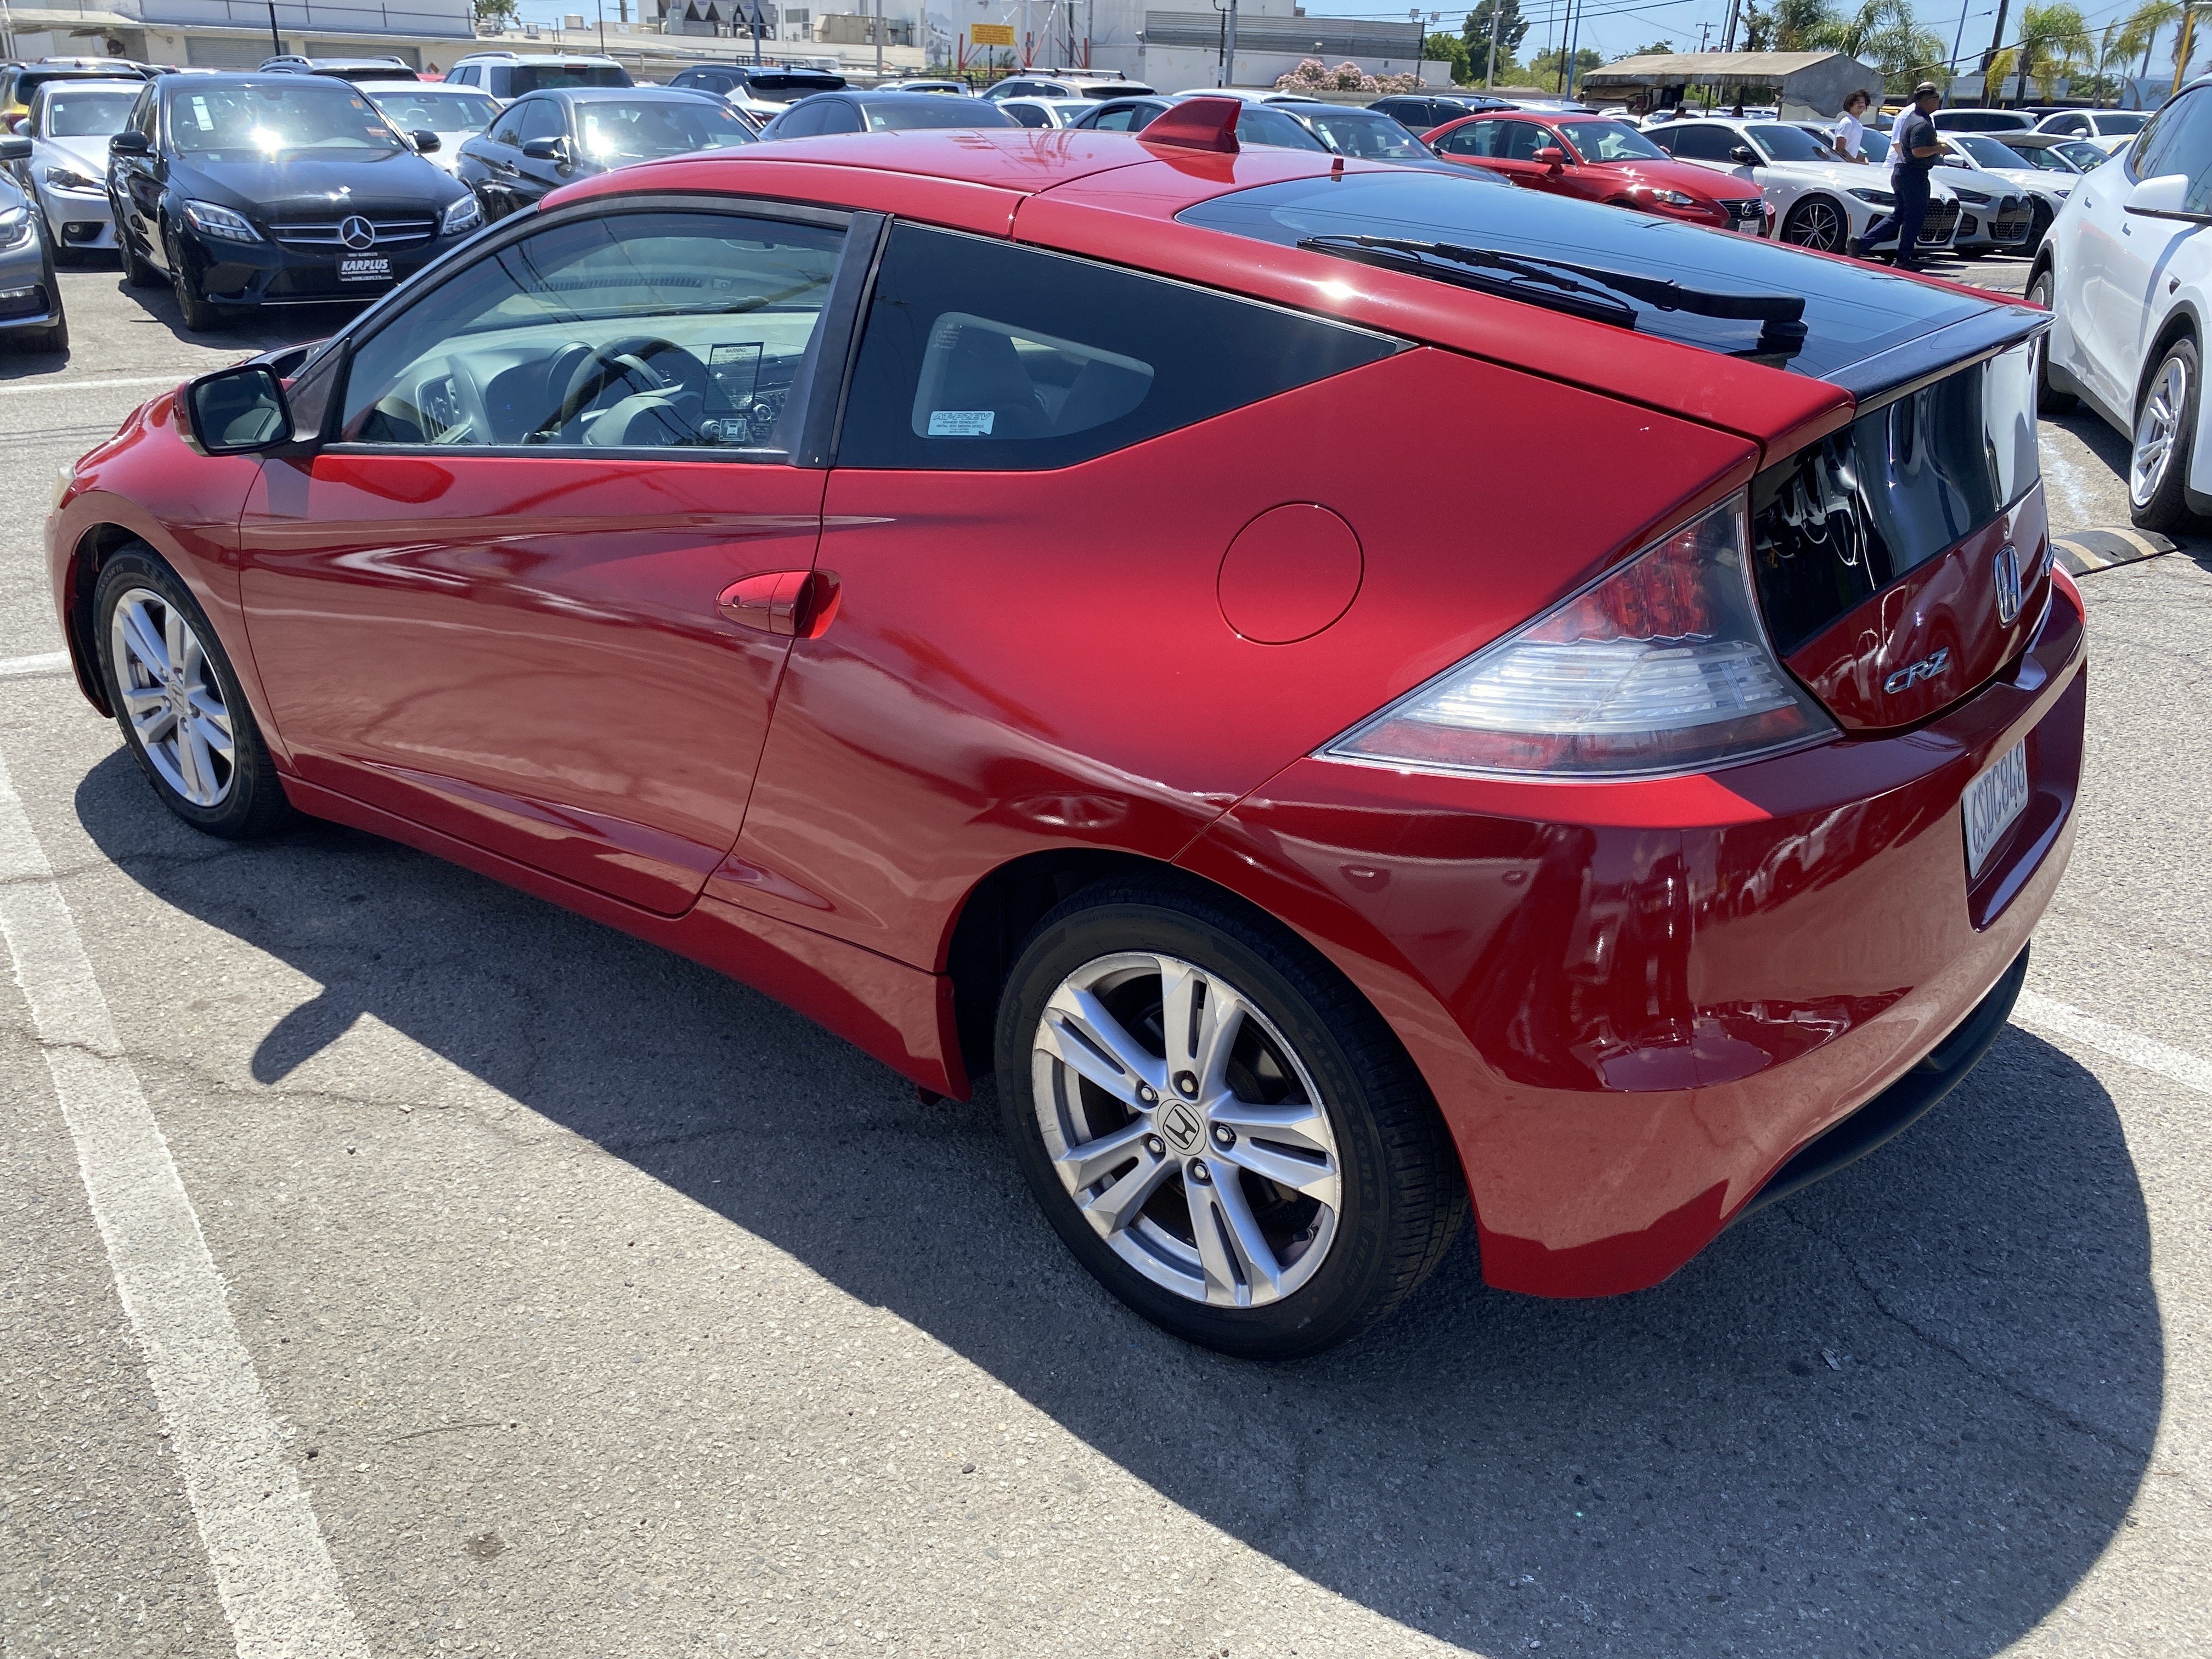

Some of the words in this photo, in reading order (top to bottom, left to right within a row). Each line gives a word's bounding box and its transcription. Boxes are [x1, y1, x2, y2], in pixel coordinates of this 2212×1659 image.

[341, 259, 388, 271] KARPLUS
[933, 413, 992, 421] AT-PZEV
[1972, 740, 2026, 854] 6SDC848
